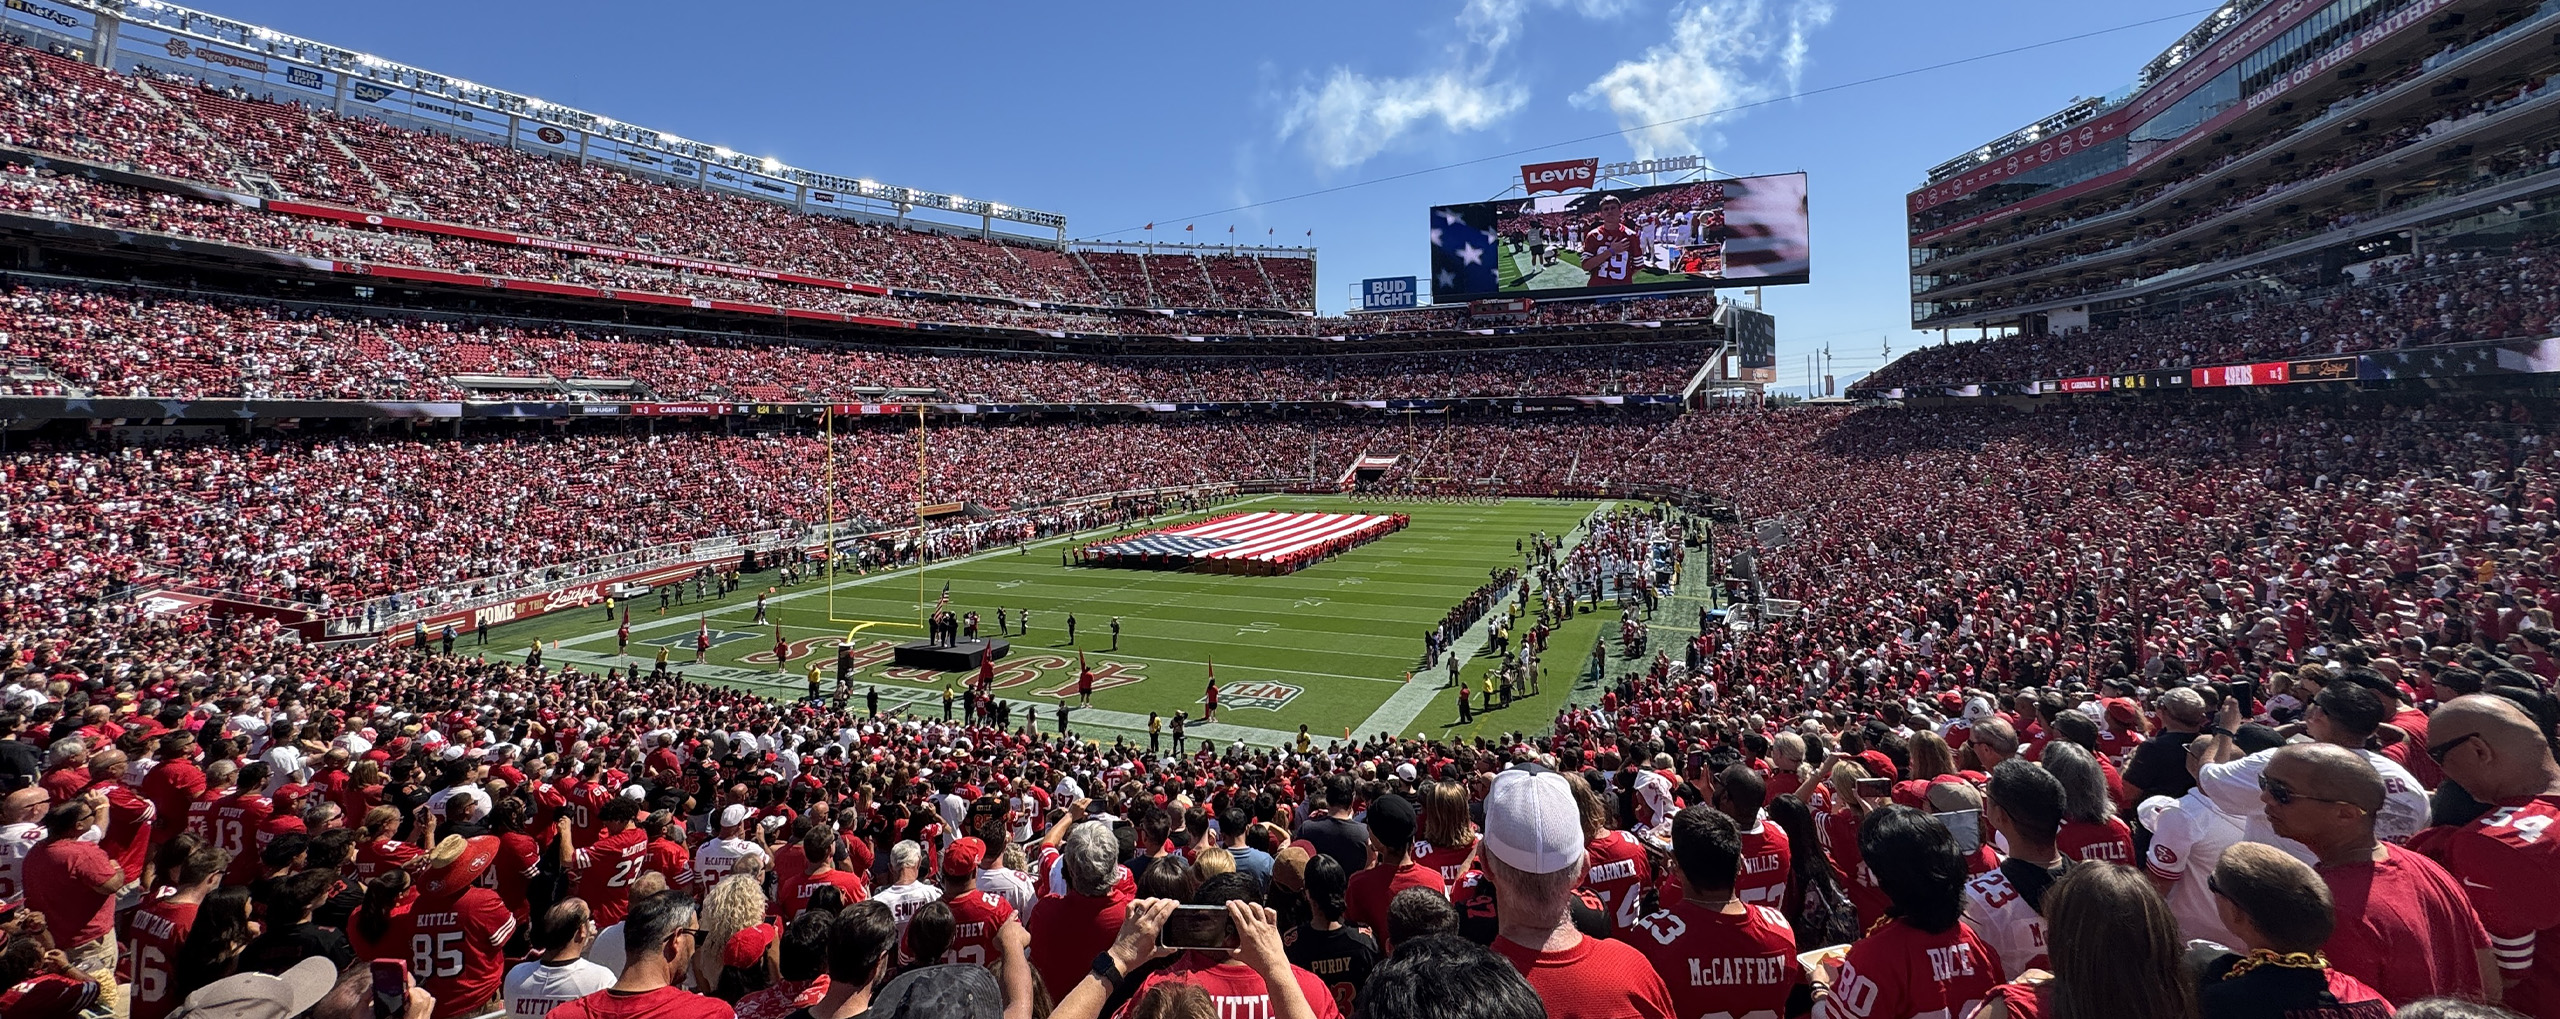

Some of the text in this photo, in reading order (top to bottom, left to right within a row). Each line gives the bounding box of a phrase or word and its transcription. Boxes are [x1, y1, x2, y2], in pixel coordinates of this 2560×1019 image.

[25, 3, 78, 27] NetApp
[197, 50, 268, 72] Dignity Health
[289, 75, 322, 89] LIGHT
[293, 69, 318, 80] BUD
[2247, 79, 2289, 110] HOME
[2293, 65, 2313, 85] OF
[2317, 41, 2353, 71] THE
[356, 86, 385, 99] SAP
[417, 102, 460, 117] UNITED
[1604, 155, 1697, 177] STADIUM
[516, 236, 530, 245] FOR
[532, 239, 573, 250] ASSISTANCE
[574, 245, 591, 253] TEXT
[1372, 281, 1406, 294] BUD
[1365, 292, 1414, 307] LIGHT
[2071, 380, 2097, 389] CARDINALS
[2224, 365, 2253, 385] 49ERS
[659, 406, 709, 414] CARDINALS
[475, 584, 603, 628] HOME OF THE Faithful
[1231, 683, 1294, 700] NFL
[2385, 777, 2409, 793] ER
[219, 806, 245, 819] PURDY
[2480, 806, 2554, 844] 54
[214, 818, 243, 857] 13
[2081, 841, 2127, 861] KITTLE
[607, 857, 645, 888] 23
[1440, 865, 1462, 880] KIT
[1590, 858, 1637, 884] WARNER
[1743, 853, 1779, 874] WILLIS
[1970, 871, 2019, 909] 23
[417, 912, 458, 928] KITTLE
[953, 921, 986, 938] FFREY
[1639, 907, 1687, 945] 23
[412, 931, 464, 978] 85
[1926, 942, 1975, 982] RICE
[130, 938, 168, 1002] 16
[1312, 957, 1352, 974] PURDY
[1688, 955, 1786, 986] McCAFFREY
[1331, 981, 1357, 1019] 3
[1838, 961, 1878, 1018] 80
[1210, 994, 1276, 1019] ITTL
